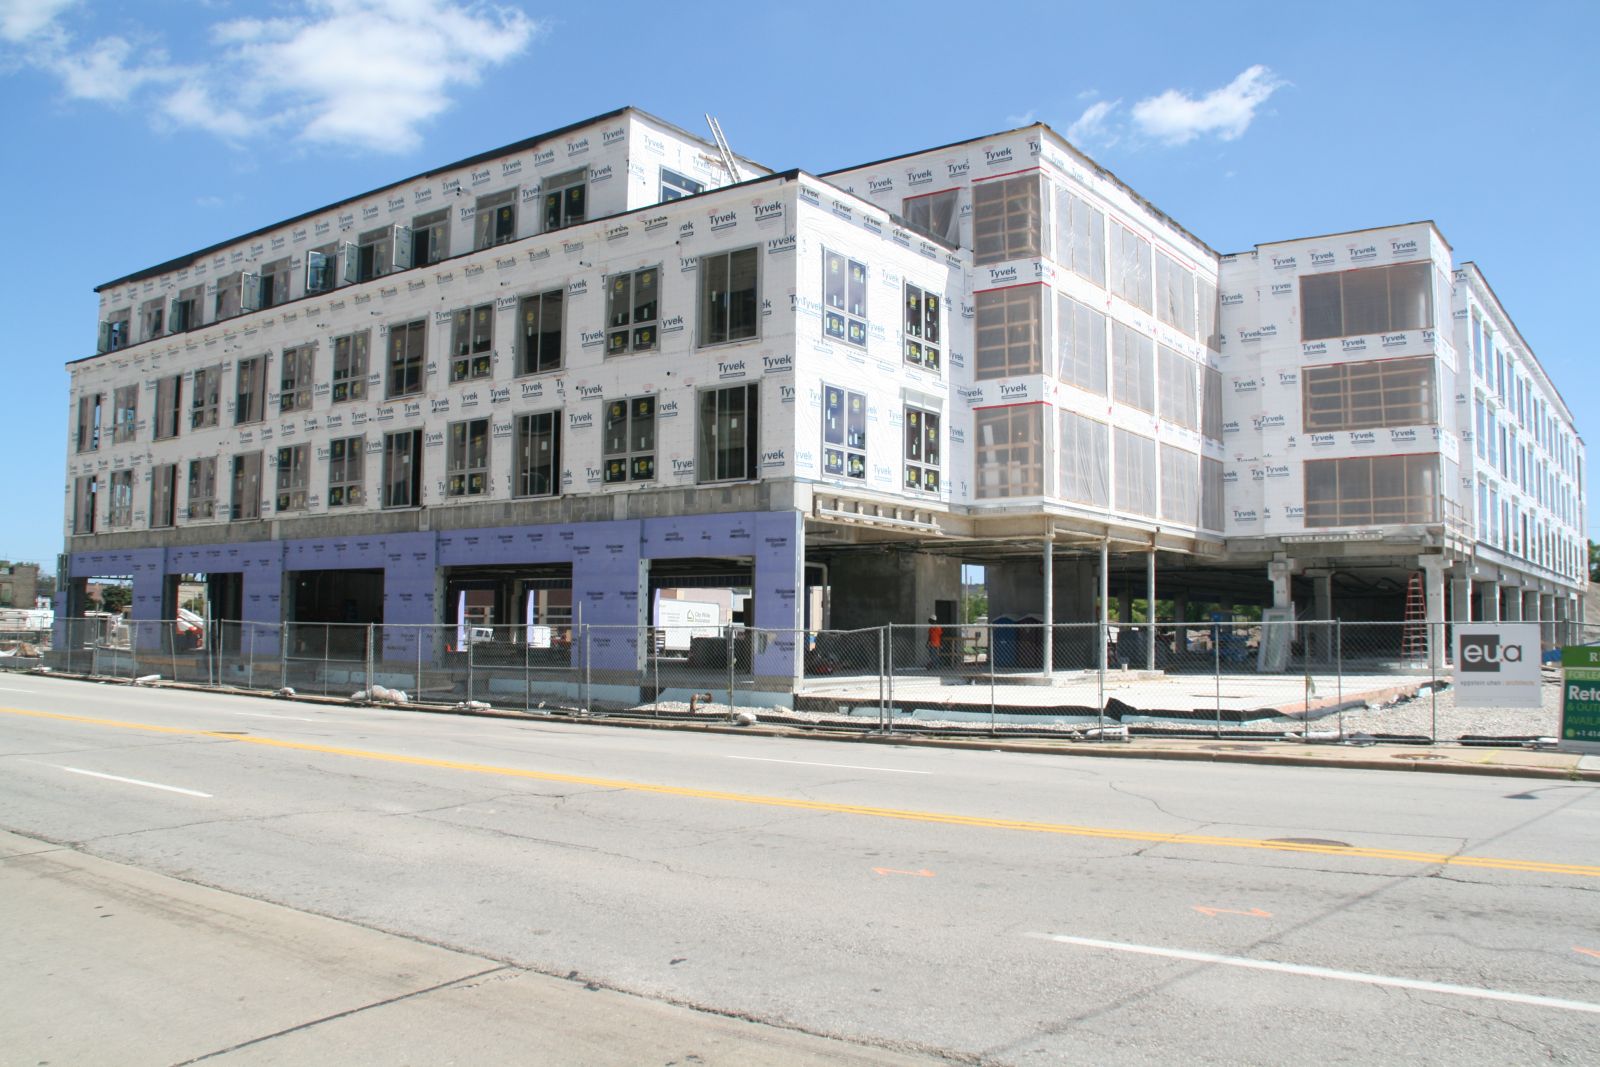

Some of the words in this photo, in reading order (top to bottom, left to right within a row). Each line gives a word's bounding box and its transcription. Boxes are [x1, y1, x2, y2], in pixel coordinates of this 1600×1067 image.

[602, 128, 624, 141] Tyvek
[568, 139, 589, 152] Tyvek
[534, 150, 554, 162] Tyvek
[986, 148, 1012, 160] Tyvek
[502, 160, 522, 172] Tyvek
[472, 170, 490, 182] Tyvek
[590, 165, 612, 178] Tyvek
[908, 168, 932, 182] Tyvek
[442, 178, 460, 190] Tyvek
[868, 178, 892, 190] Tyvek
[415, 188, 432, 200] Tyvek
[388, 198, 404, 208] Tyvek
[460, 206, 476, 217] Tyve
[753, 201, 782, 216] Tyvek
[709, 211, 736, 225] Tyvek
[1392, 240, 1416, 250] Tyvek
[1350, 246, 1376, 256] Tyvek
[1273, 257, 1296, 266] Tyvek
[1310, 252, 1334, 261] Tyvek
[990, 267, 1016, 279] Tyvek
[568, 280, 587, 290] yvek
[1222, 293, 1243, 302] Tyvek
[662, 316, 683, 328] yvek
[581, 330, 604, 342] Tyvek
[1240, 330, 1261, 339] Tyvek
[1381, 334, 1406, 343] Tyvek
[1303, 342, 1326, 352] Tyvek
[1342, 338, 1366, 348] Tyvek
[762, 355, 792, 368] Tyvek
[718, 361, 745, 373] Tyvek
[522, 382, 542, 393] Tyvek
[1000, 383, 1028, 395] Tyvek
[1234, 380, 1256, 388] Tyvek
[490, 388, 510, 398] Tyvek
[580, 384, 602, 396] Tyvek
[780, 386, 796, 396] Tyv
[968, 388, 984, 397] vek
[432, 398, 449, 409] Tyvek
[377, 407, 394, 416] Tyvek
[570, 412, 592, 422] Tyvek
[1262, 414, 1284, 423] Tyvek
[493, 423, 512, 433] Tyvek
[426, 432, 443, 442] Tyvek
[1312, 434, 1334, 442] Tyvek
[1350, 432, 1374, 440] Tyvek
[1390, 429, 1416, 438] Tyvek
[318, 448, 330, 457] Tyve
[762, 450, 784, 462] yvek
[796, 451, 812, 460] yvek
[1266, 465, 1288, 474] Tyvek
[1234, 510, 1256, 518] Tyvek
